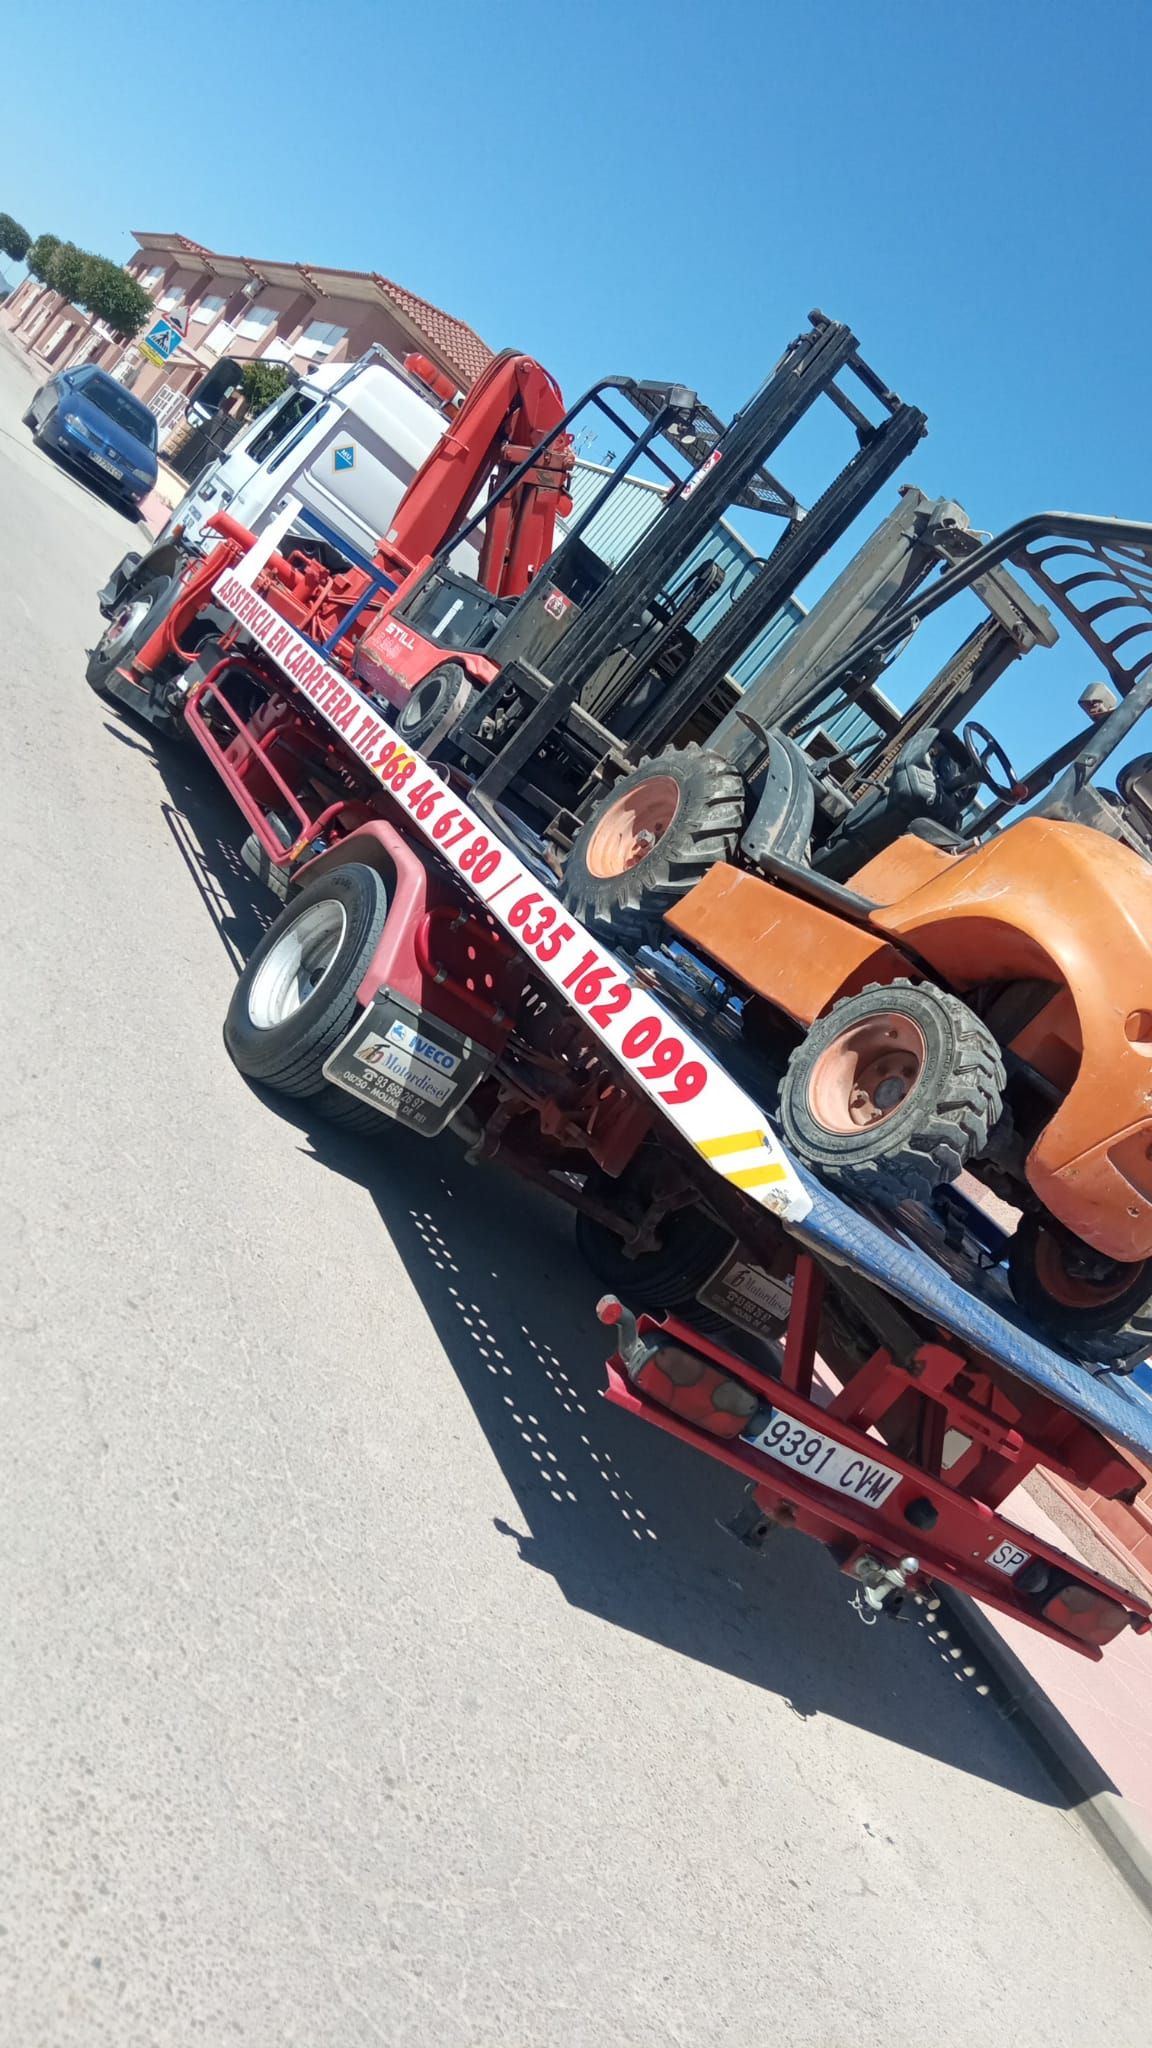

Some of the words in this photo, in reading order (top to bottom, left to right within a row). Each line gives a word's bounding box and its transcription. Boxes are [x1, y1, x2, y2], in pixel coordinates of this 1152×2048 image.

[384, 621, 417, 650] STILL
[218, 577, 274, 640] ASISTENCIA
[267, 625, 292, 657] EN
[283, 642, 360, 732] CARRETERA
[408, 780, 444, 821] 46
[432, 809, 475, 850] 67
[459, 836, 502, 884] 80
[508, 893, 575, 962] 635
[562, 950, 632, 1029] 162
[622, 1016, 708, 1104] 099
[408, 1035, 456, 1071] IVECO
[374, 1074, 388, 1089] 93
[385, 1081, 404, 1098] 668
[381, 1051, 450, 1103] Motordiesel
[762, 1419, 837, 1475] 9391
[839, 1459, 894, 1503] CVM
[992, 1545, 1026, 1571] SP
